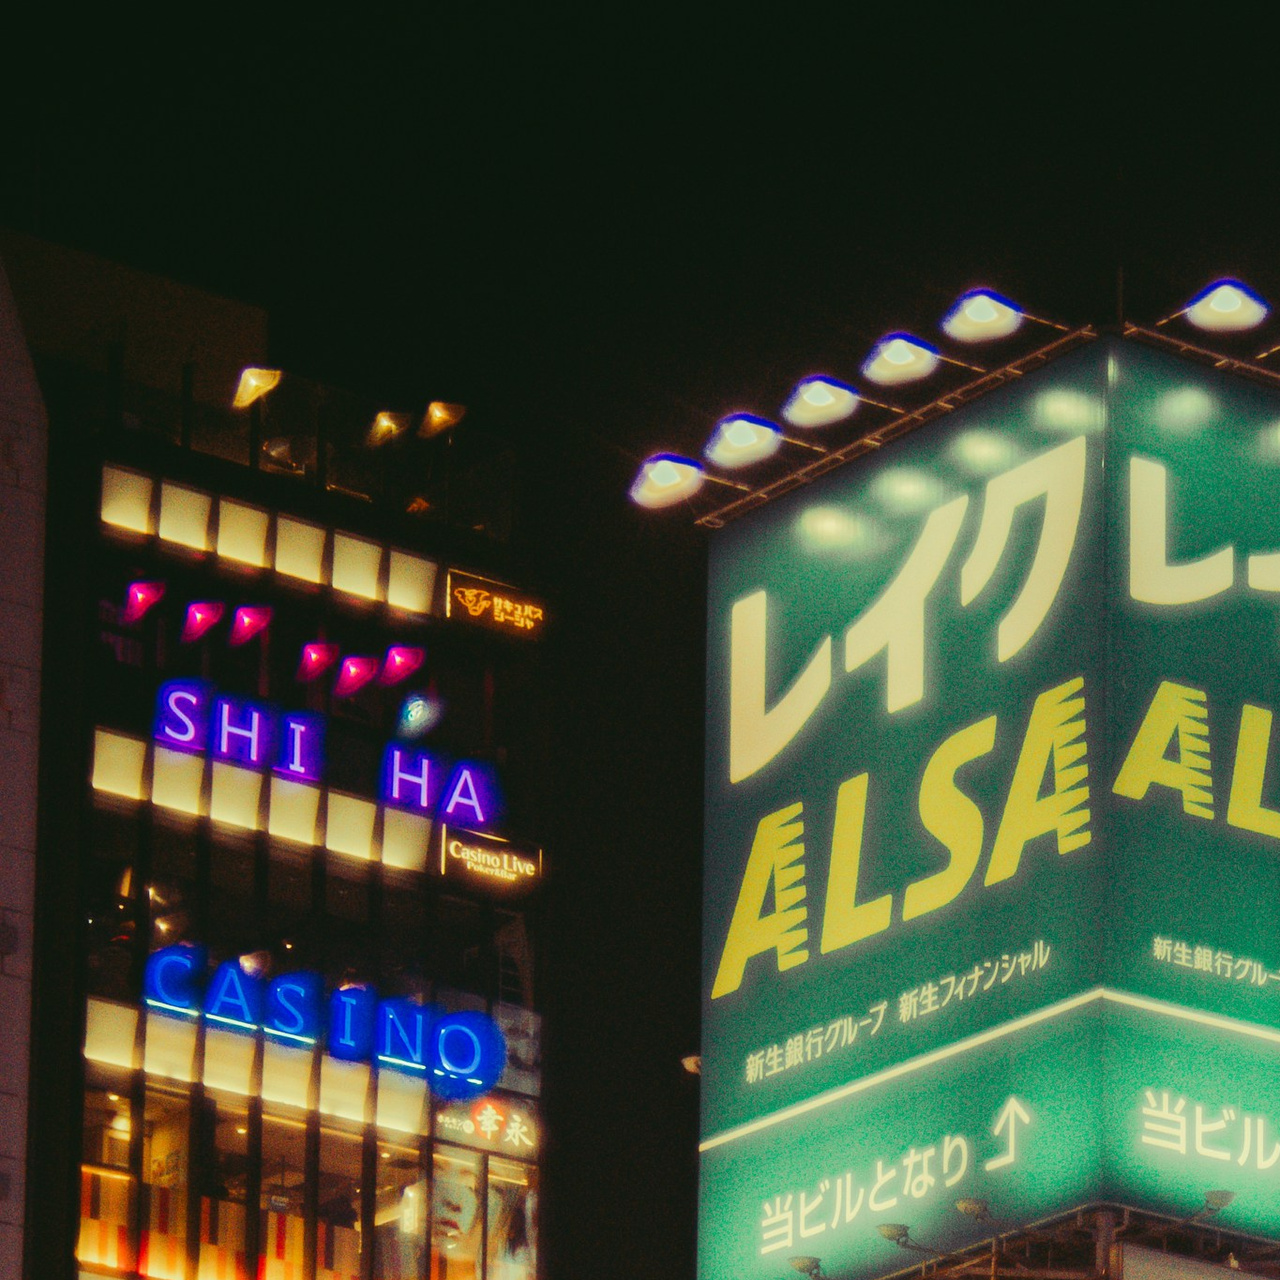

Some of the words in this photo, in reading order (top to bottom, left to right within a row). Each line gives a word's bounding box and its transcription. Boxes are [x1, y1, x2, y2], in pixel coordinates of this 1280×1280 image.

[730, 436, 1086, 784] レイク
[450, 841, 500, 868] Casino
[503, 854, 536, 876] Live
[711, 676, 1091, 999] ALSA
[157, 956, 482, 1074] CASINO
[746, 1001, 888, 1083] 新生銀行グループ
[900, 940, 1050, 1023] 新生フィナンシャル
[761, 1135, 968, 1254] 当ビルとなり
